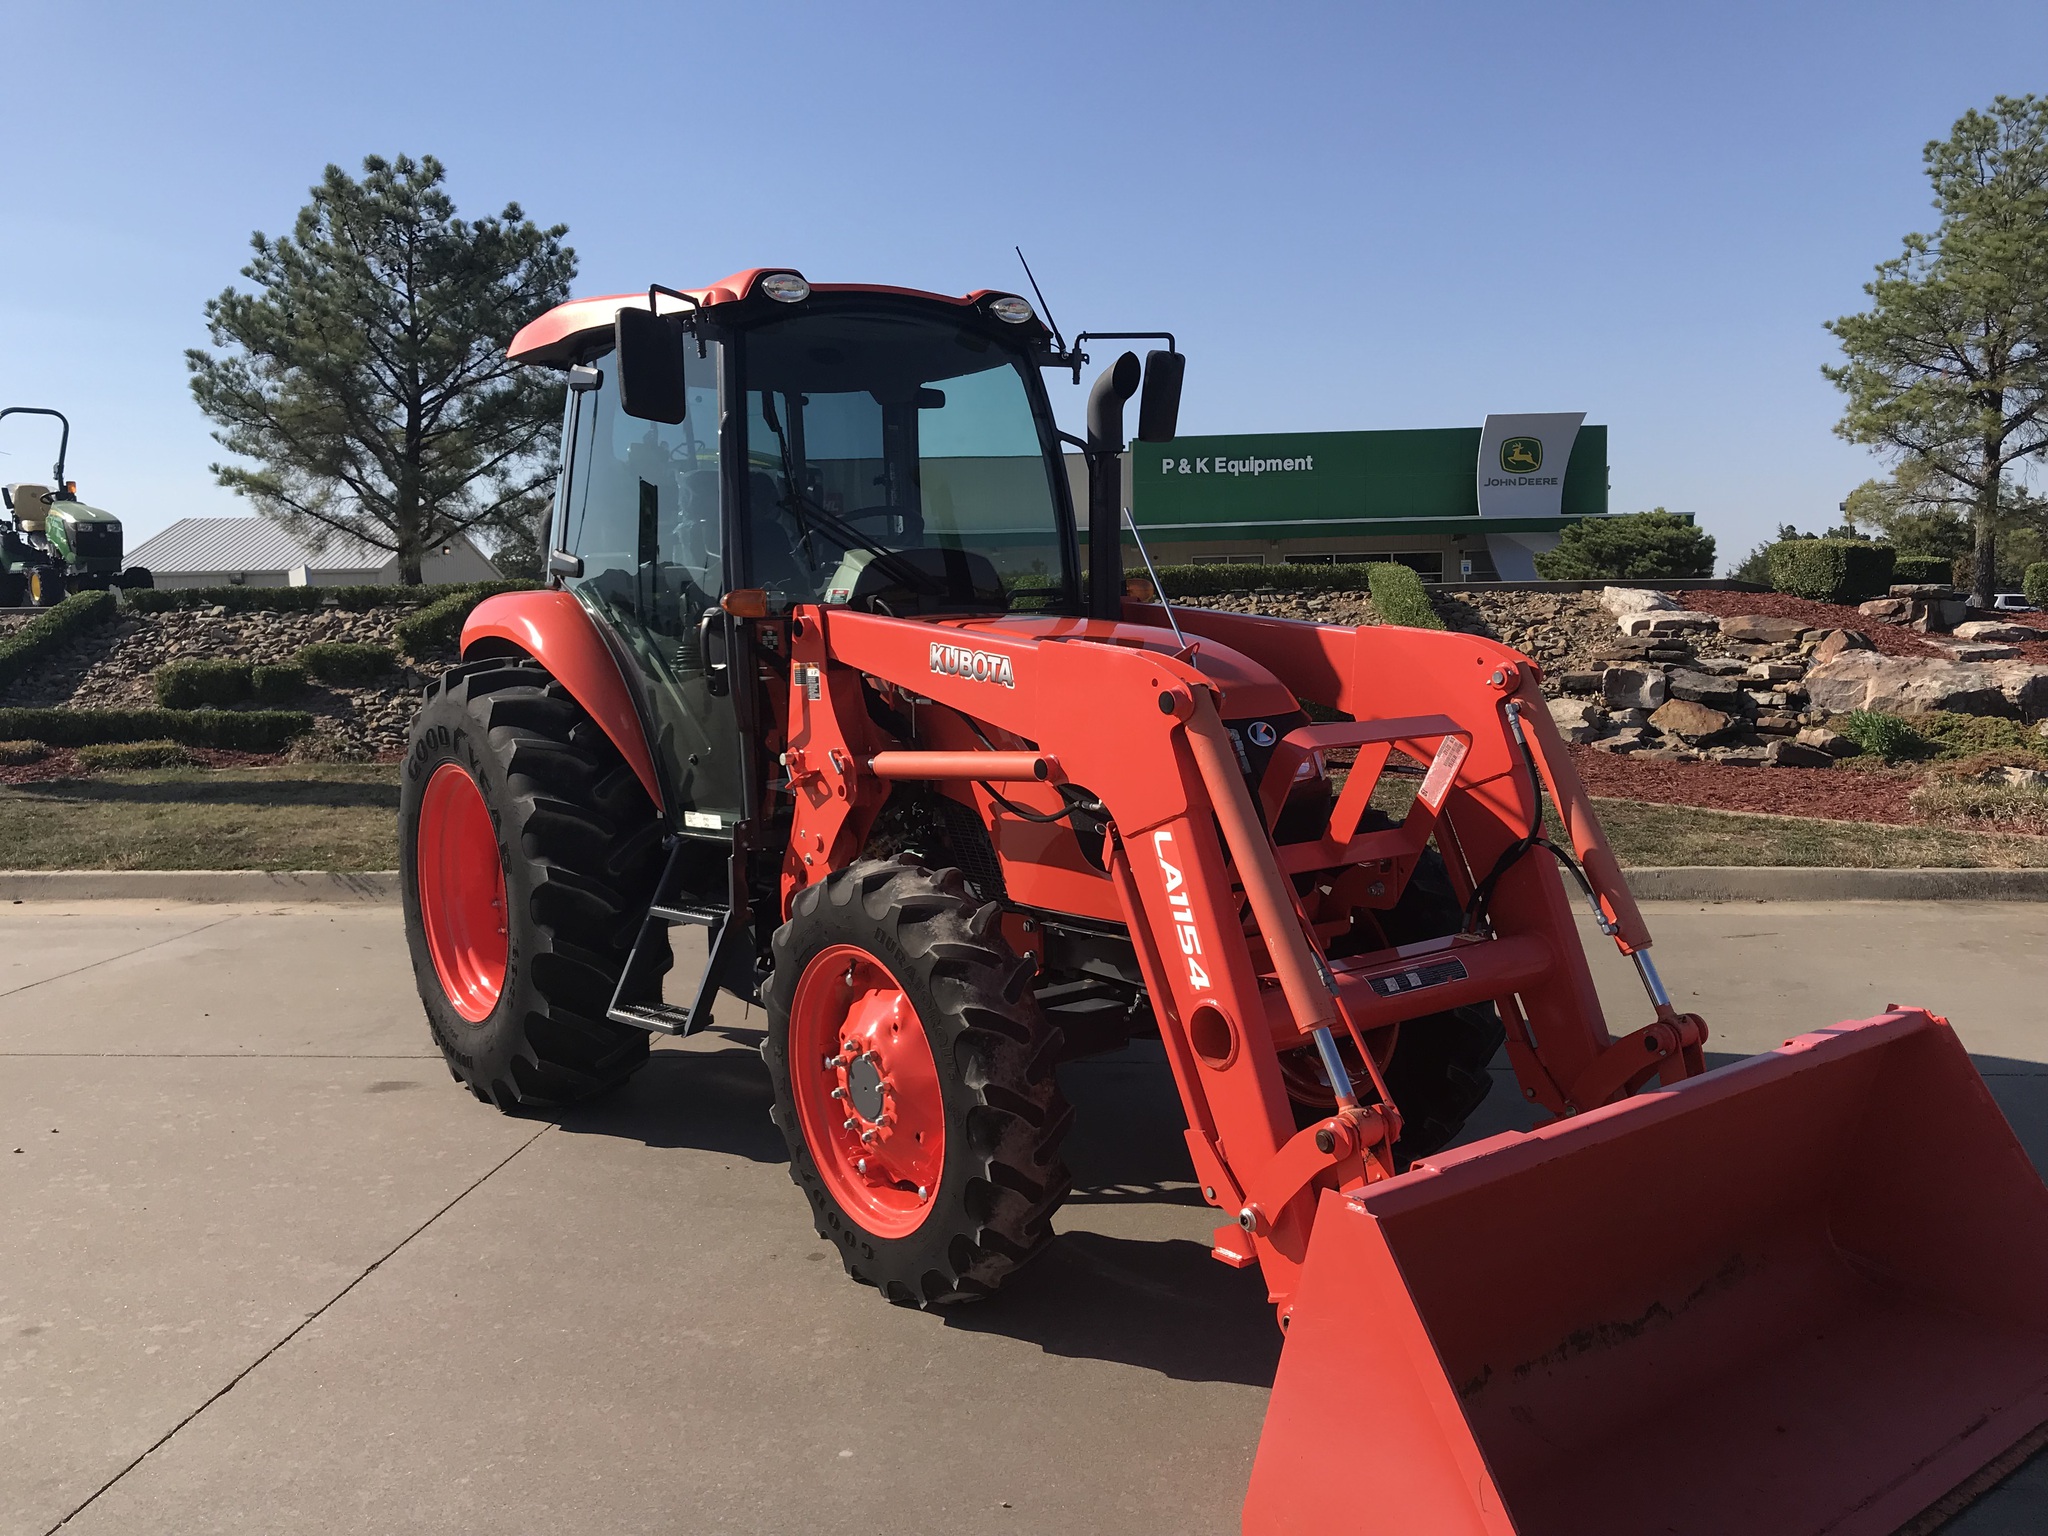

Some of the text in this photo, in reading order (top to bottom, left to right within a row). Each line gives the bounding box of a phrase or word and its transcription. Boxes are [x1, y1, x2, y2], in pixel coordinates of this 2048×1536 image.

[1162, 455, 1313, 476] P & K Equipment
[1483, 476, 1558, 487] JOHN DEERE
[930, 642, 1015, 690] KUBOTA
[1153, 830, 1211, 990] LA1154
